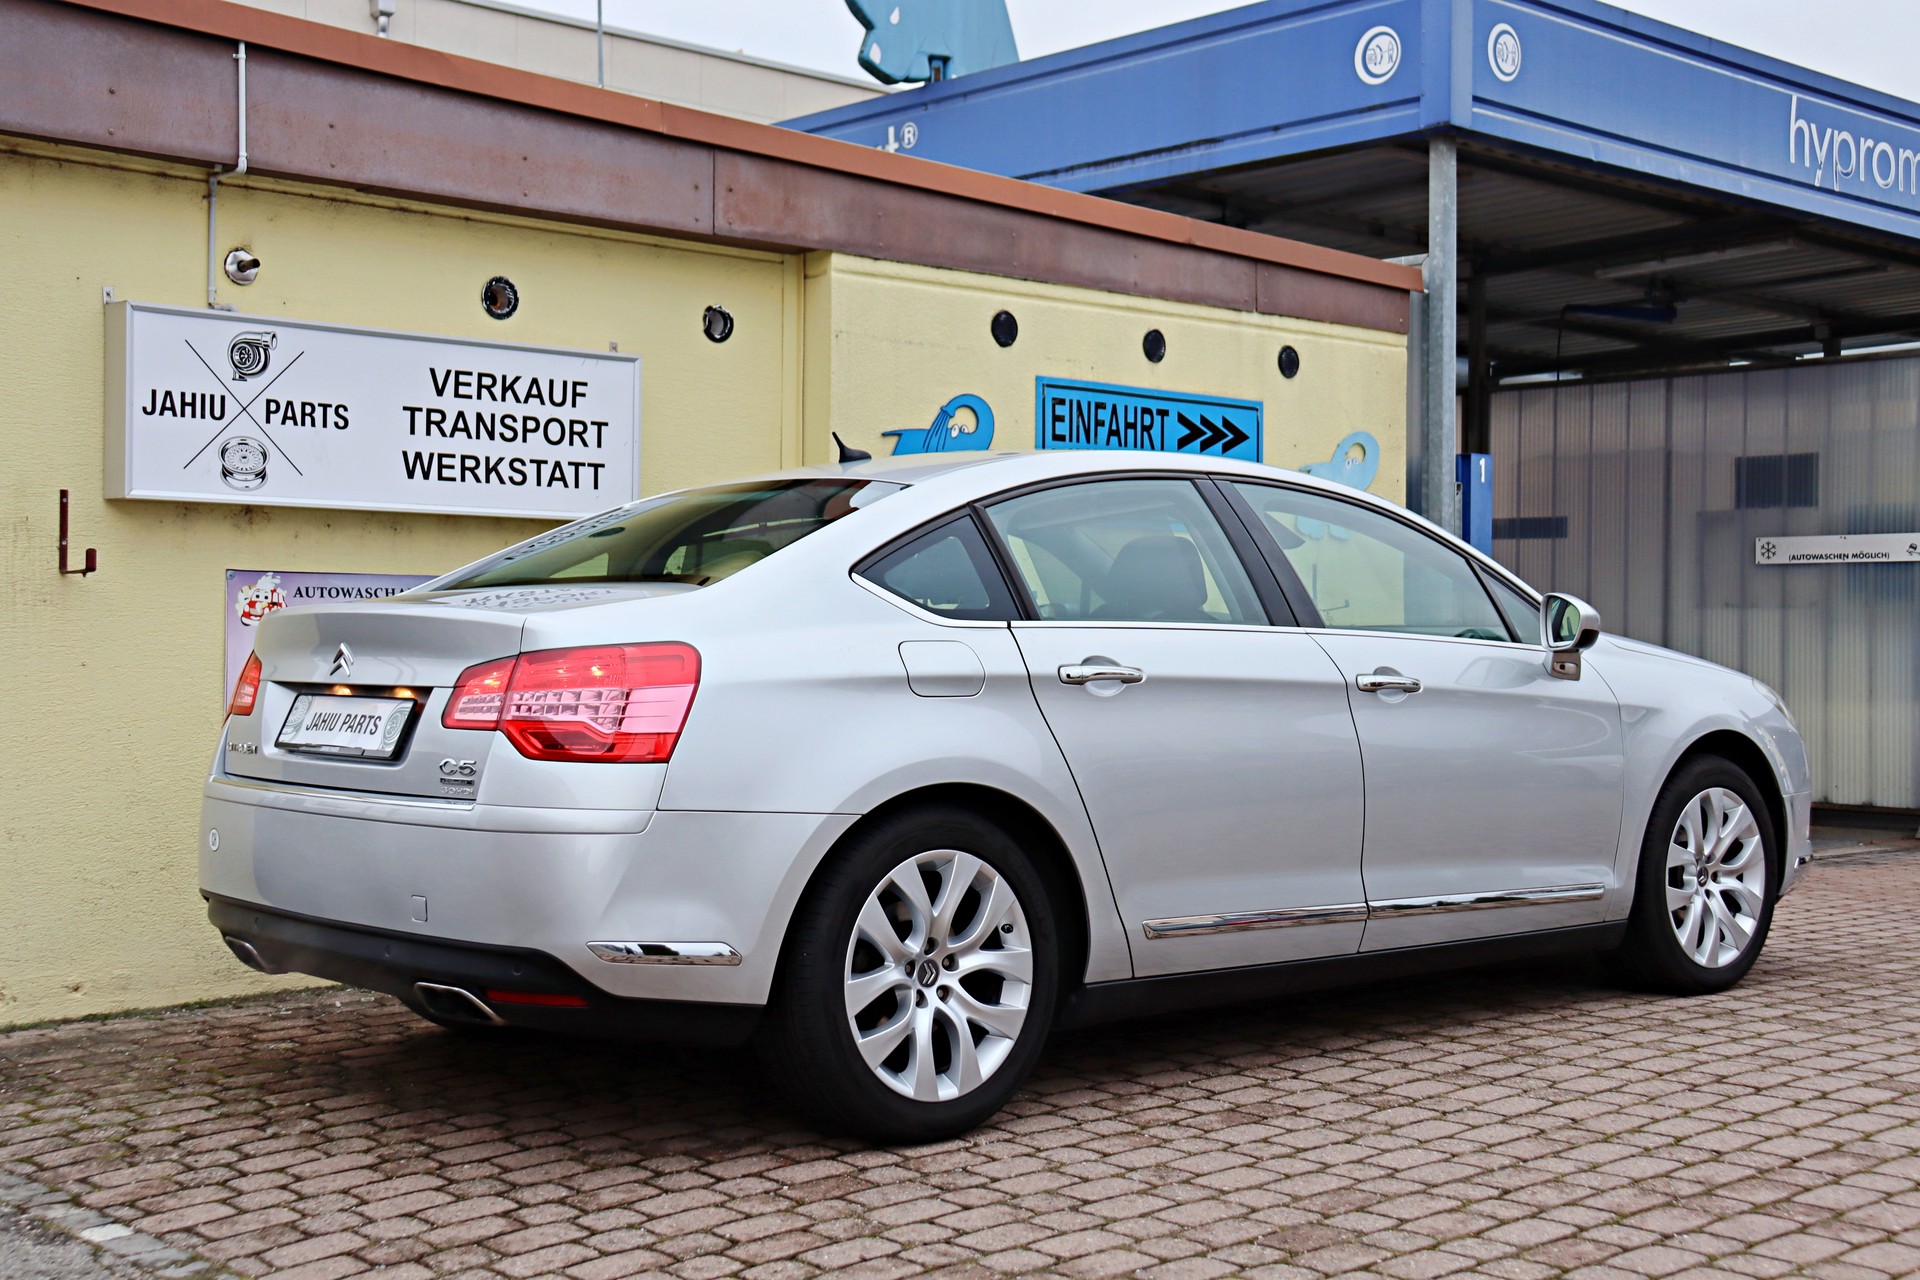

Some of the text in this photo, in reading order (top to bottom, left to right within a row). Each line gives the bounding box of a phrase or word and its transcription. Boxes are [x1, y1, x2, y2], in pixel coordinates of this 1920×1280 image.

[429, 367, 588, 408] VERKAUF
[142, 388, 349, 430] JAHIU PARTS
[402, 405, 609, 449] TRANSPORT
[1051, 396, 1170, 451] EINFAHRT
[401, 450, 606, 490] WERKSTATT
[1479, 457, 1486, 483] 1
[293, 586, 411, 599] AUTOWASCH
[305, 712, 382, 735] JAHIU PARTS
[439, 757, 477, 777] C5
